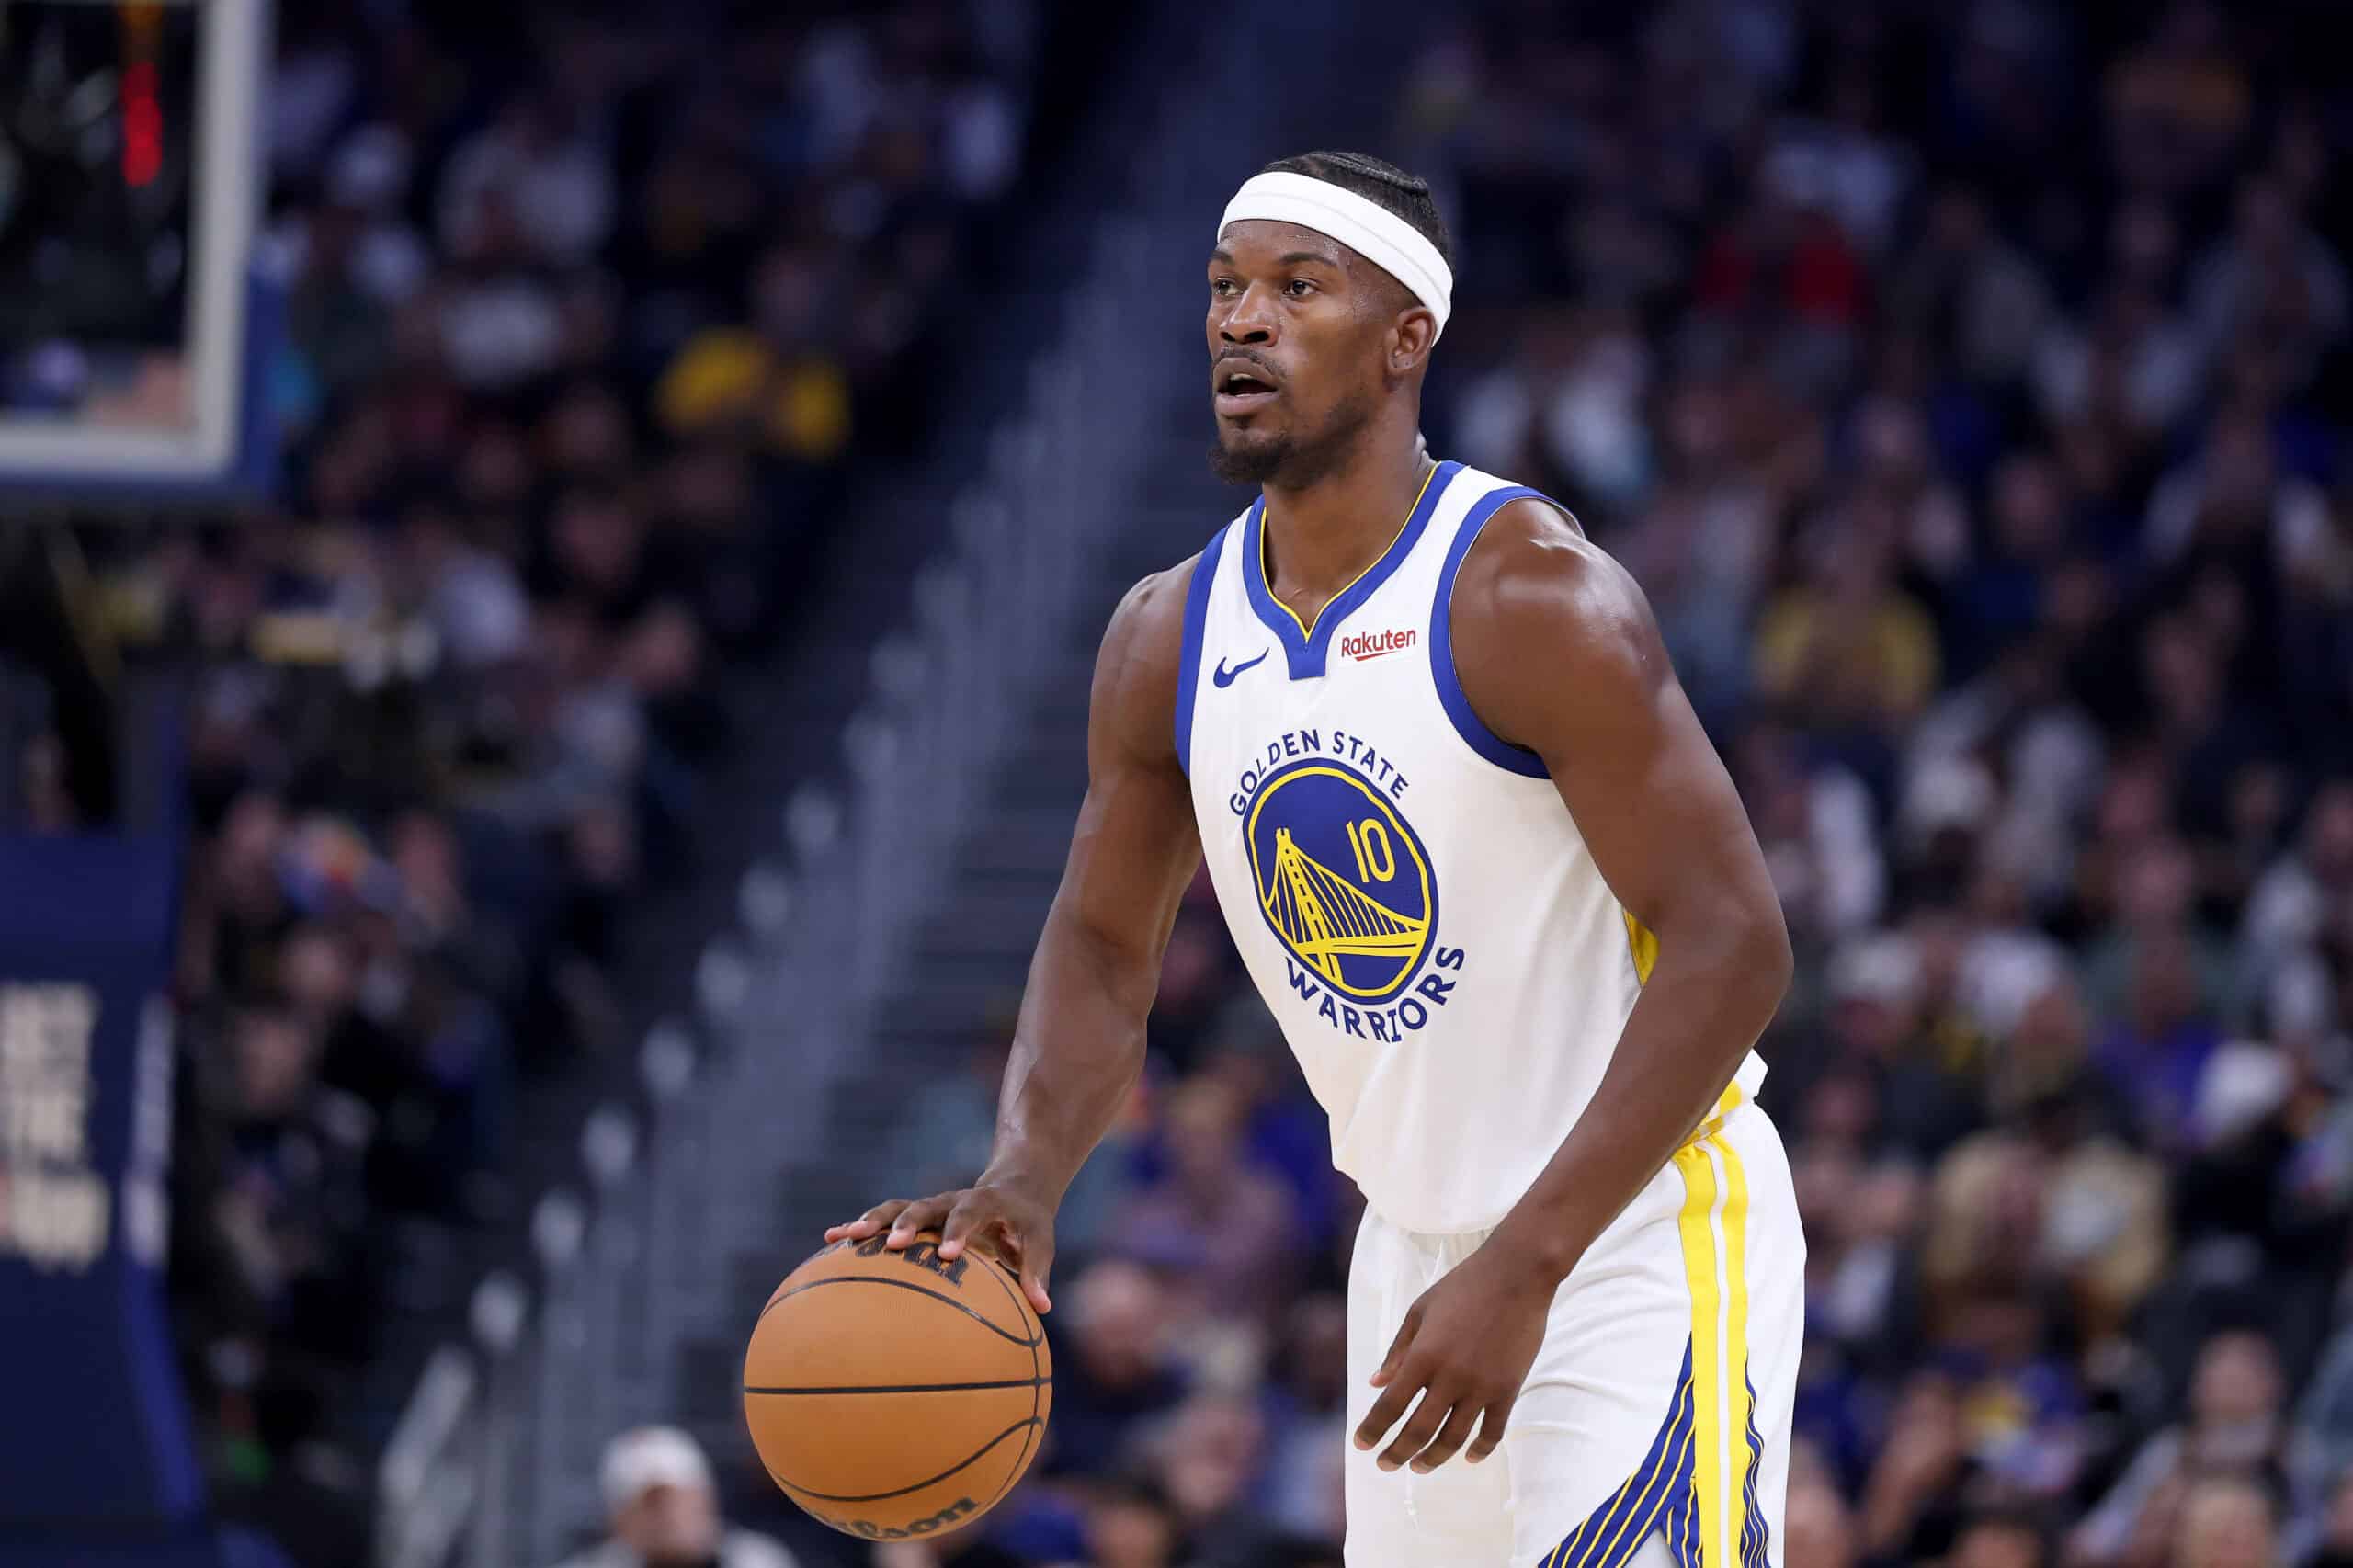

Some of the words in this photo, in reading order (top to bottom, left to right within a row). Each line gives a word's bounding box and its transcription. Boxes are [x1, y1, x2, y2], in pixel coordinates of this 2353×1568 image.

[1341, 630, 1415, 658] Rakuten
[1230, 729, 1321, 816] GOLDEN
[1333, 731, 1409, 799] STATE
[1346, 818, 1395, 882] 10
[1285, 947, 1464, 1043] WARRIORS
